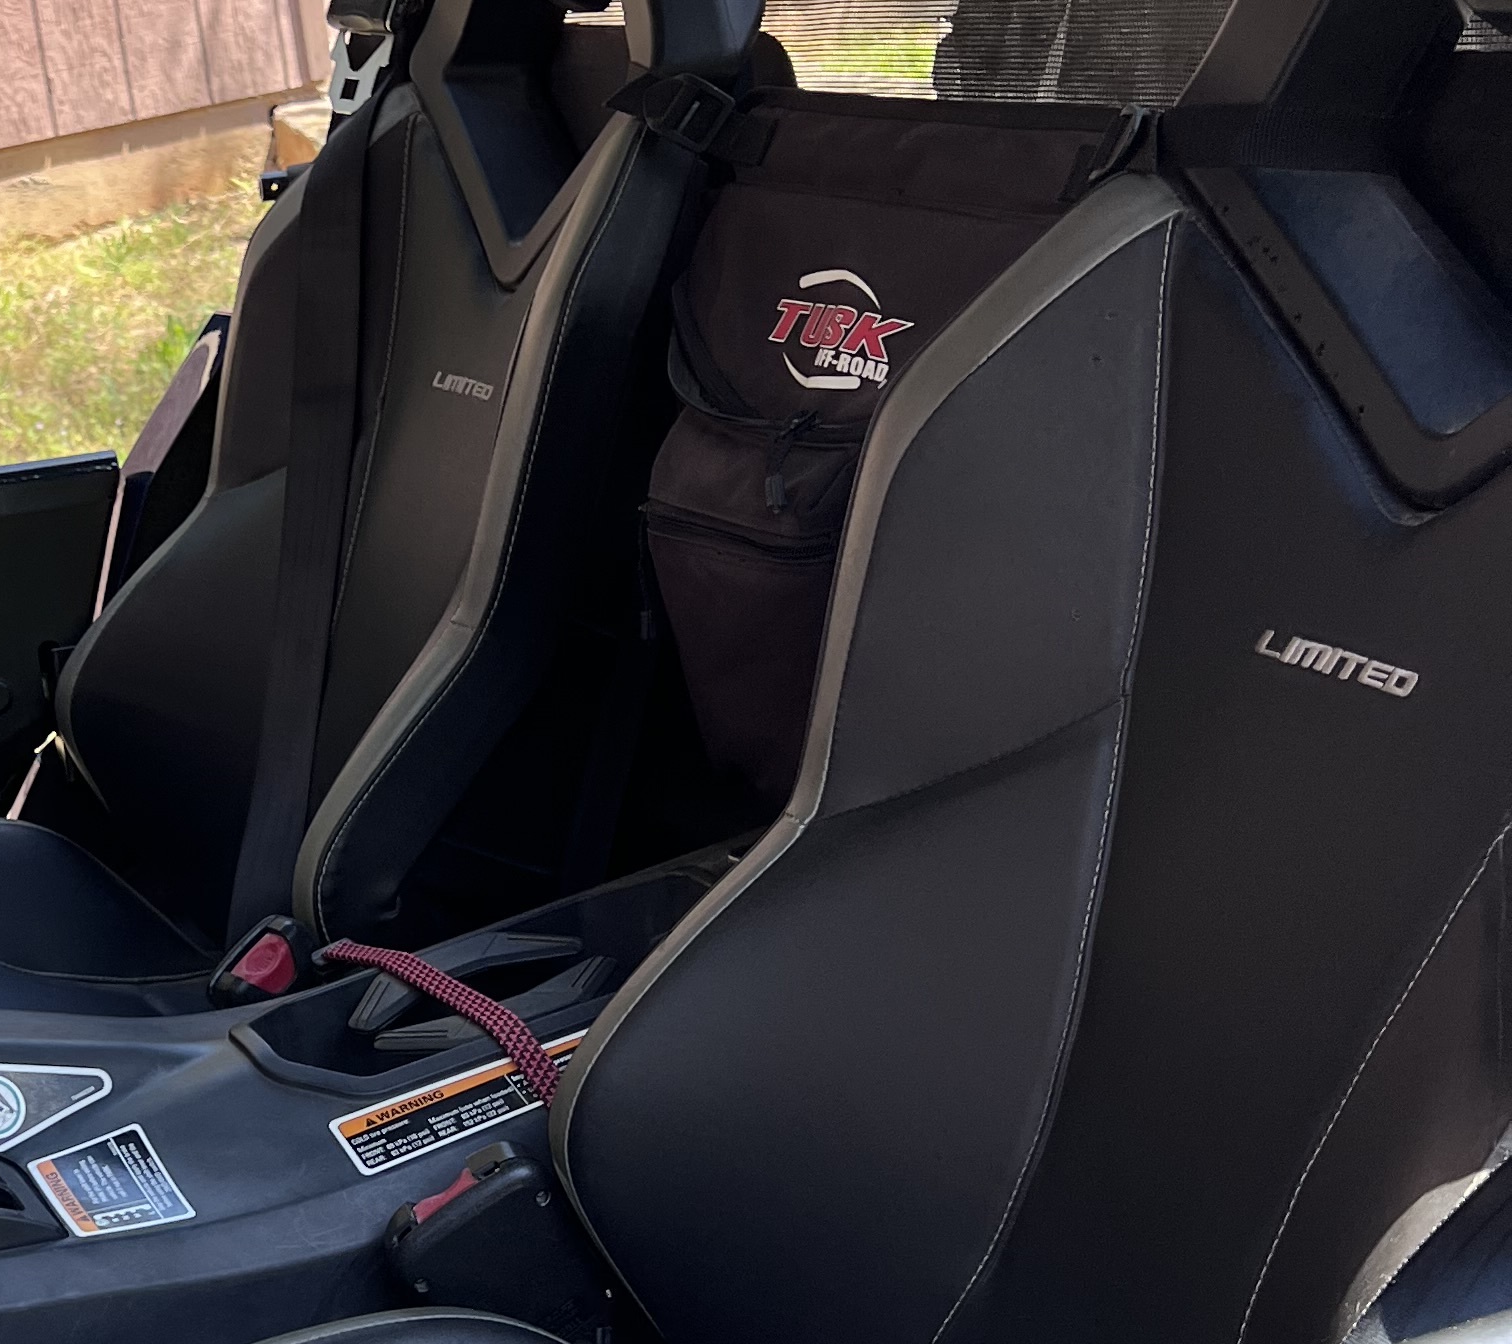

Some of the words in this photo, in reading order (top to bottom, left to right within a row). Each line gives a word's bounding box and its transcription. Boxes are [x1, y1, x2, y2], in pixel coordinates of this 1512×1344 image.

[768, 299, 915, 363] TUSK
[432, 370, 494, 401] LIMITED
[1254, 629, 1419, 698] LIMITED
[375, 1090, 445, 1122] WARNING
[45, 1172, 84, 1216] WARNING
